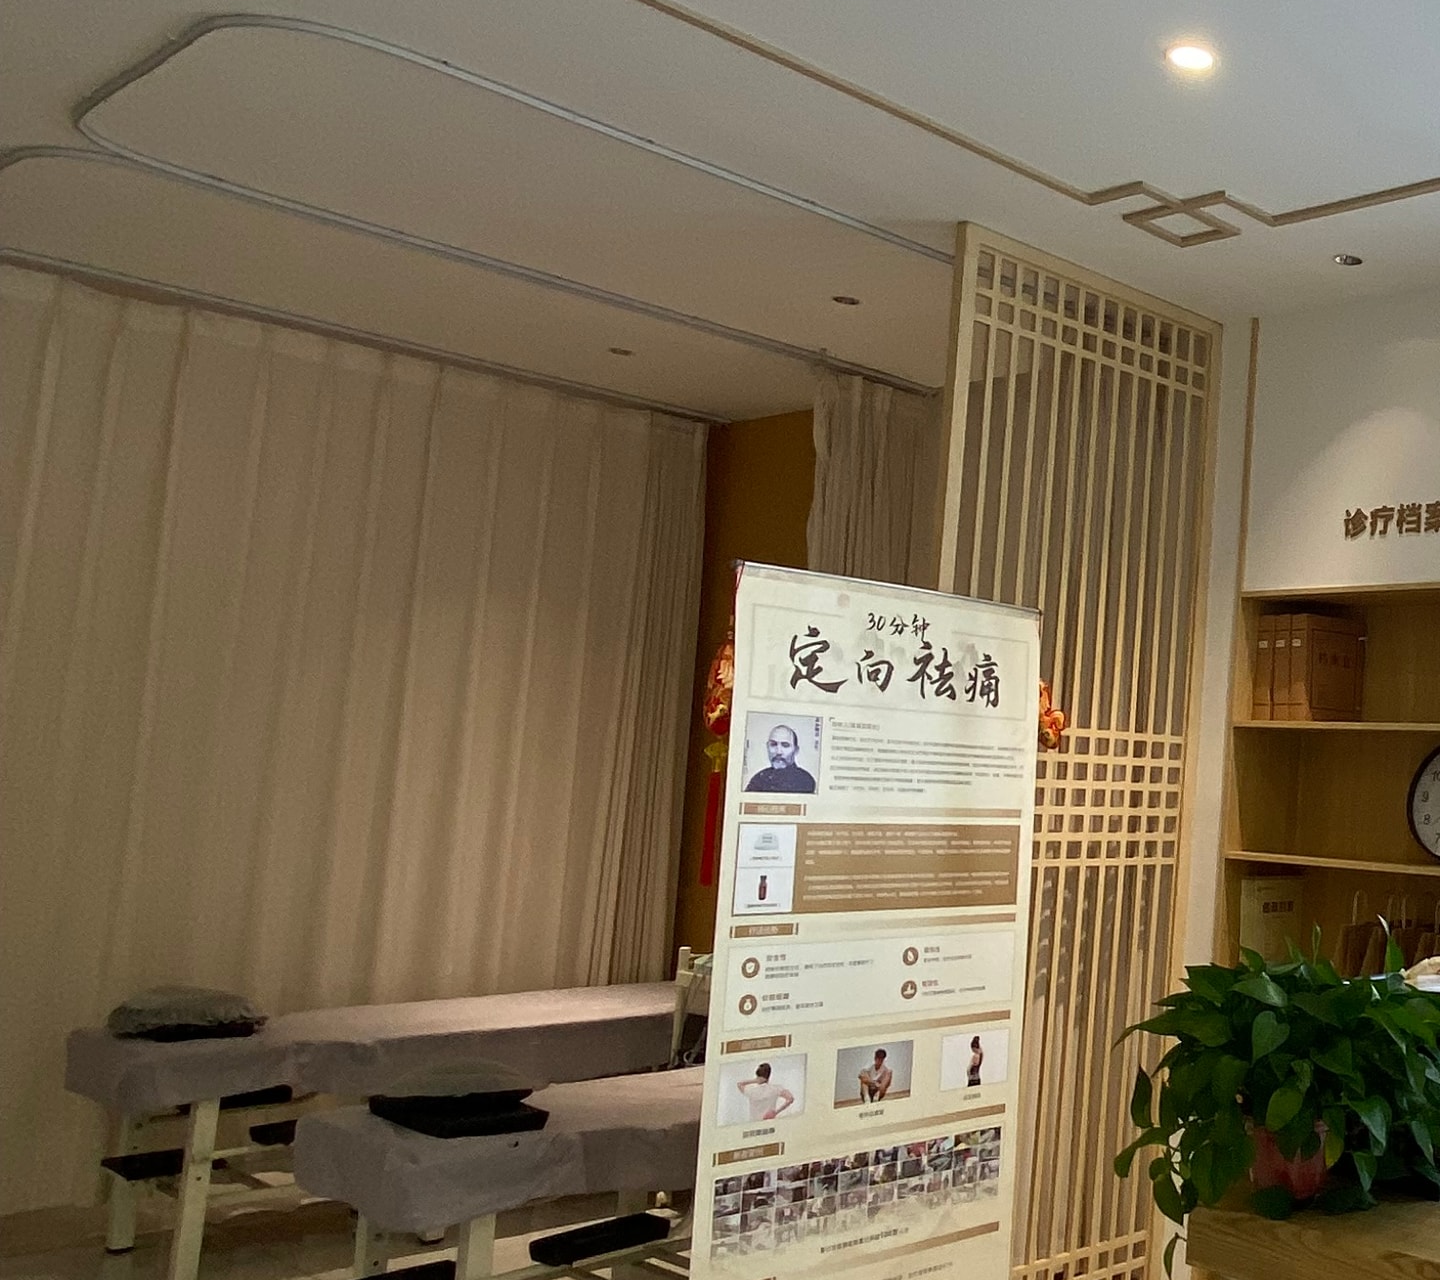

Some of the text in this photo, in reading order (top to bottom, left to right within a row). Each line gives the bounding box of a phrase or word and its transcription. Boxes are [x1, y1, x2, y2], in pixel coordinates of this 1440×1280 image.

[867, 612, 931, 642] 30分钟
[788, 625, 1001, 708] 定向祛痛
